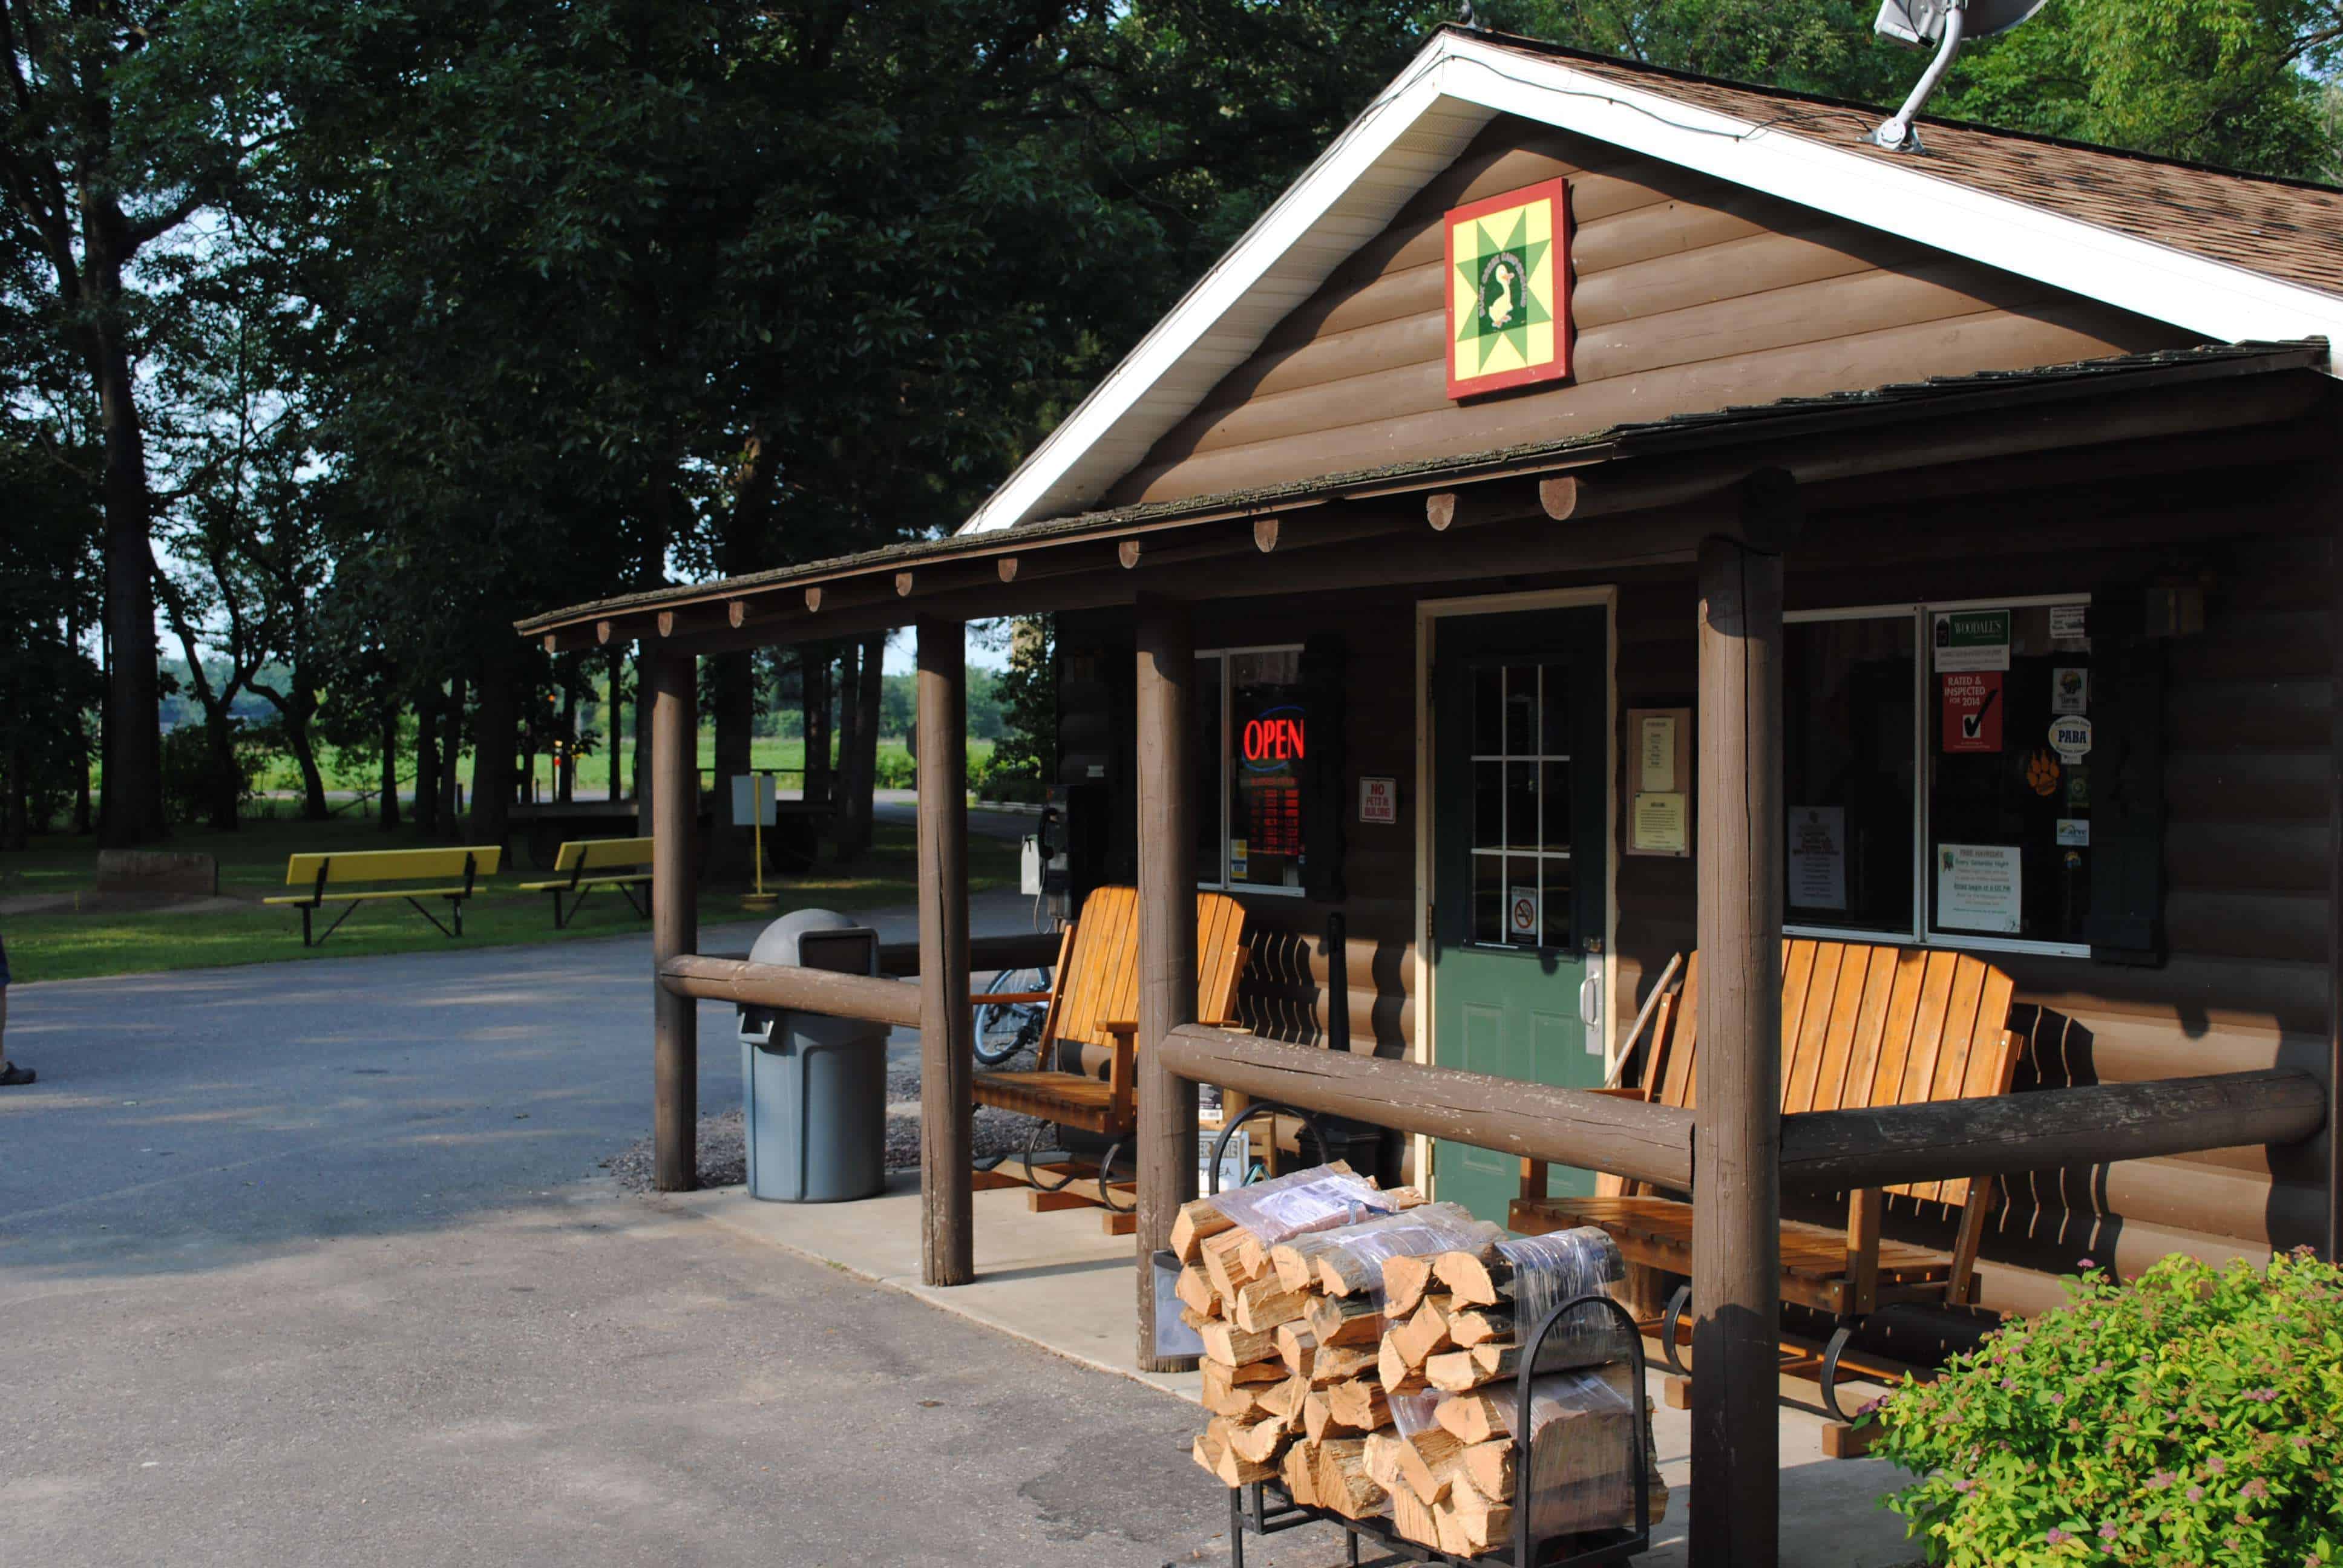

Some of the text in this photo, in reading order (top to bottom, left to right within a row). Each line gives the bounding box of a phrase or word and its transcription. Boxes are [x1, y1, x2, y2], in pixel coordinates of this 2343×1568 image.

[1947, 676, 1982, 686] RATED &
[1944, 686, 1985, 696] INSPECTED
[1962, 696, 1981, 707] 2014
[1244, 717, 1305, 760] OPEN
[2057, 730, 2087, 744] PABA
[1371, 783, 1385, 795] NO
